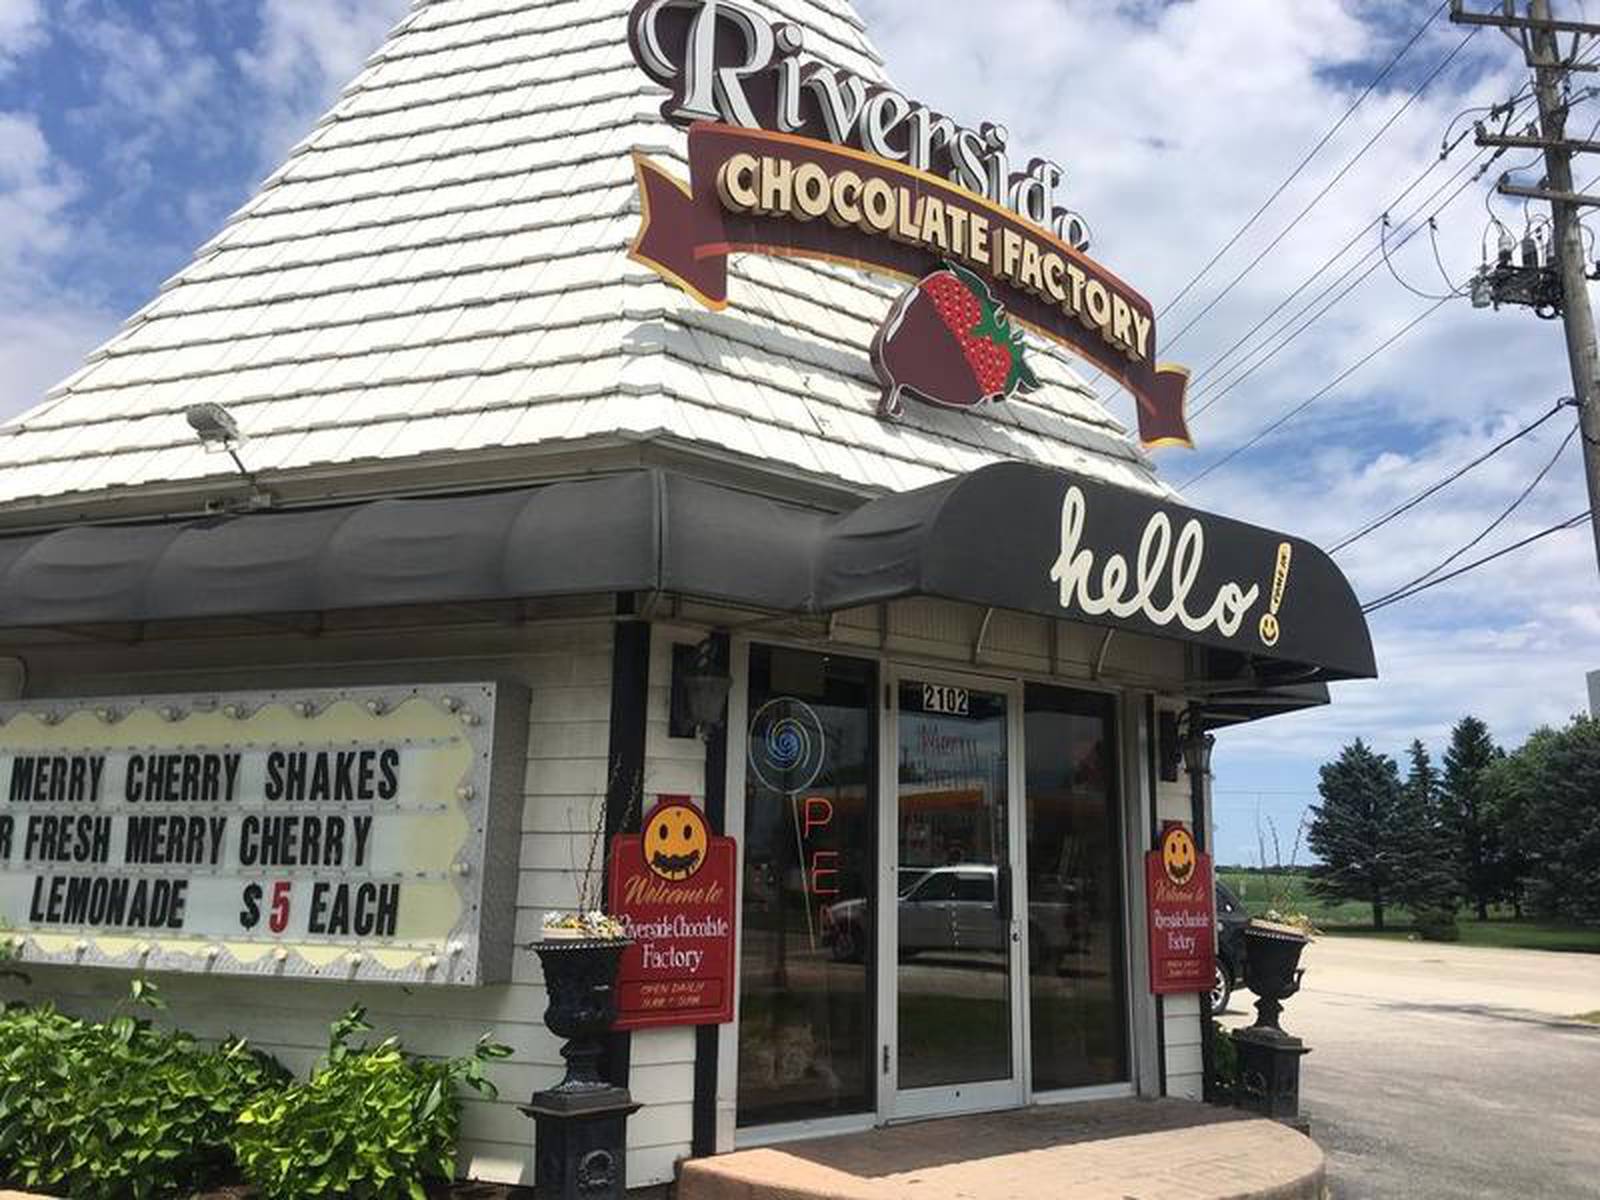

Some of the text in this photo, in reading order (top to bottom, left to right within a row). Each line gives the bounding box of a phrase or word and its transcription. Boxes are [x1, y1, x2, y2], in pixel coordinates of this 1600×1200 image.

[629, 0, 1092, 252] Riverside
[718, 153, 1152, 361] CHOCOLATE FACTORY
[924, 685, 968, 714] 2102
[9, 748, 399, 802] MERRY CHERRY SHAKES
[25, 815, 112, 862] FRESH
[125, 816, 228, 865] MERRY
[239, 815, 373, 866] CHERRY
[29, 875, 189, 929] LEMONADE
[308, 882, 400, 936] EACH
[624, 875, 703, 905] Welcome
[673, 913, 729, 938] Chocolate
[643, 943, 703, 973] Factory
